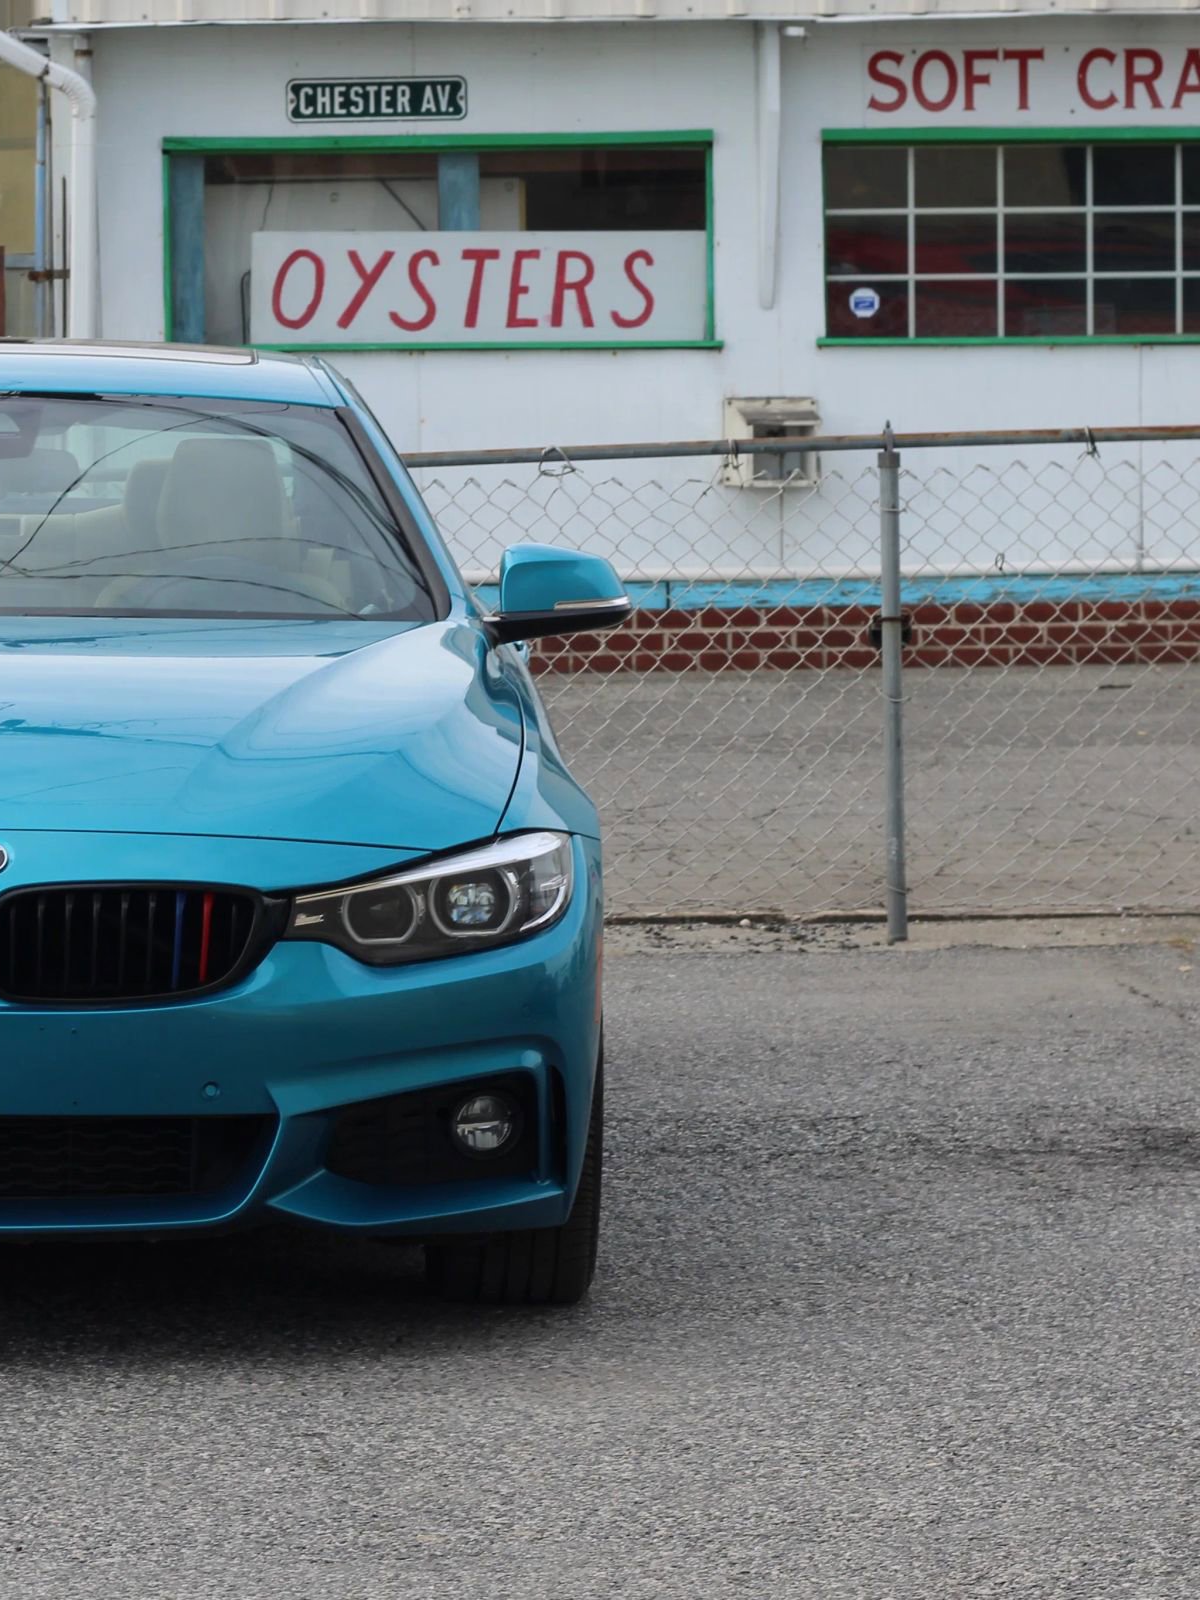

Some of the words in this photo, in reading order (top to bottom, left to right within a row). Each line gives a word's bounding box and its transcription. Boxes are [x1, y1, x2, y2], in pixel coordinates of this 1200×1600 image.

[299, 85, 411, 115] CHESTER
[420, 84, 454, 113] AV.
[866, 48, 1045, 112] SOFT
[1077, 47, 1200, 110] CRA
[271, 248, 655, 332] OYSTERS
